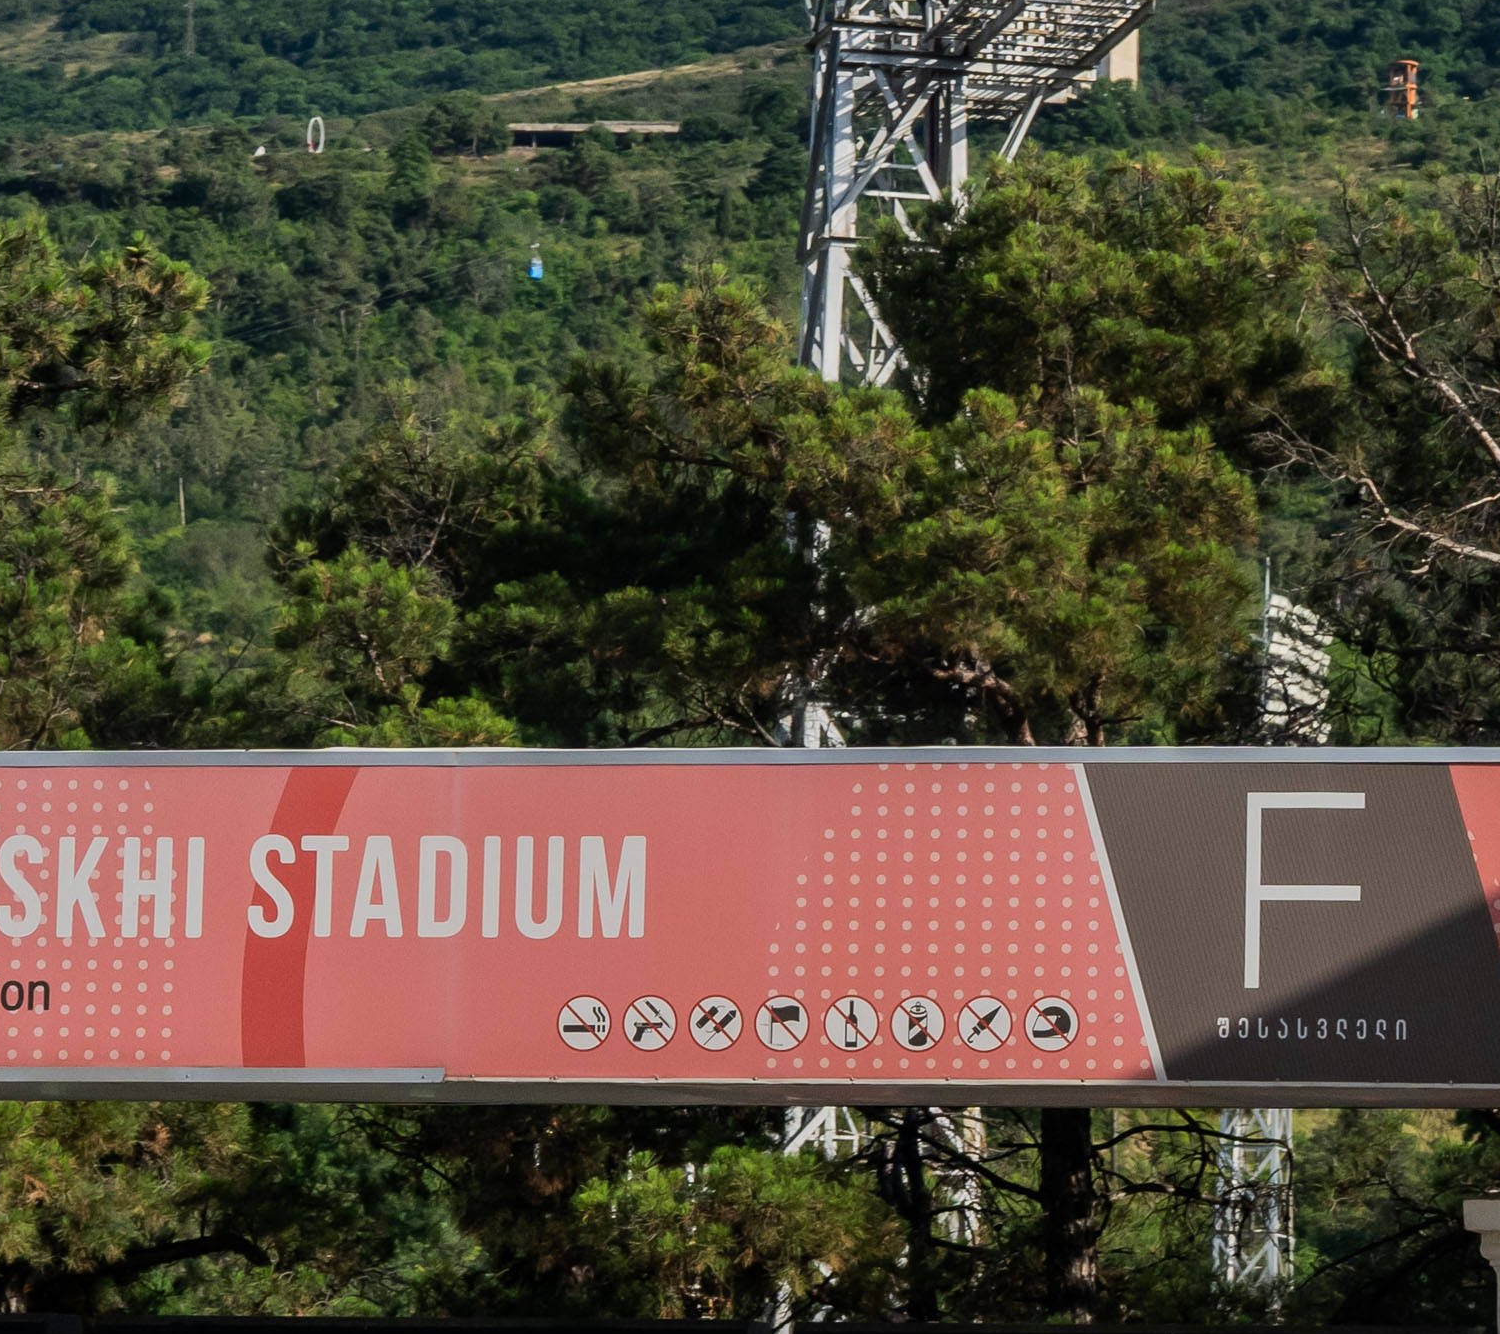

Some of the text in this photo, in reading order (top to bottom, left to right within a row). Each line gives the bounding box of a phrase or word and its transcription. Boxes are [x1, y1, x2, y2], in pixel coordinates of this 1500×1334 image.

[246, 833, 648, 941] STADIUM
[1242, 790, 1367, 990] F
[1215, 1015, 1409, 1042] შესასვლელი
